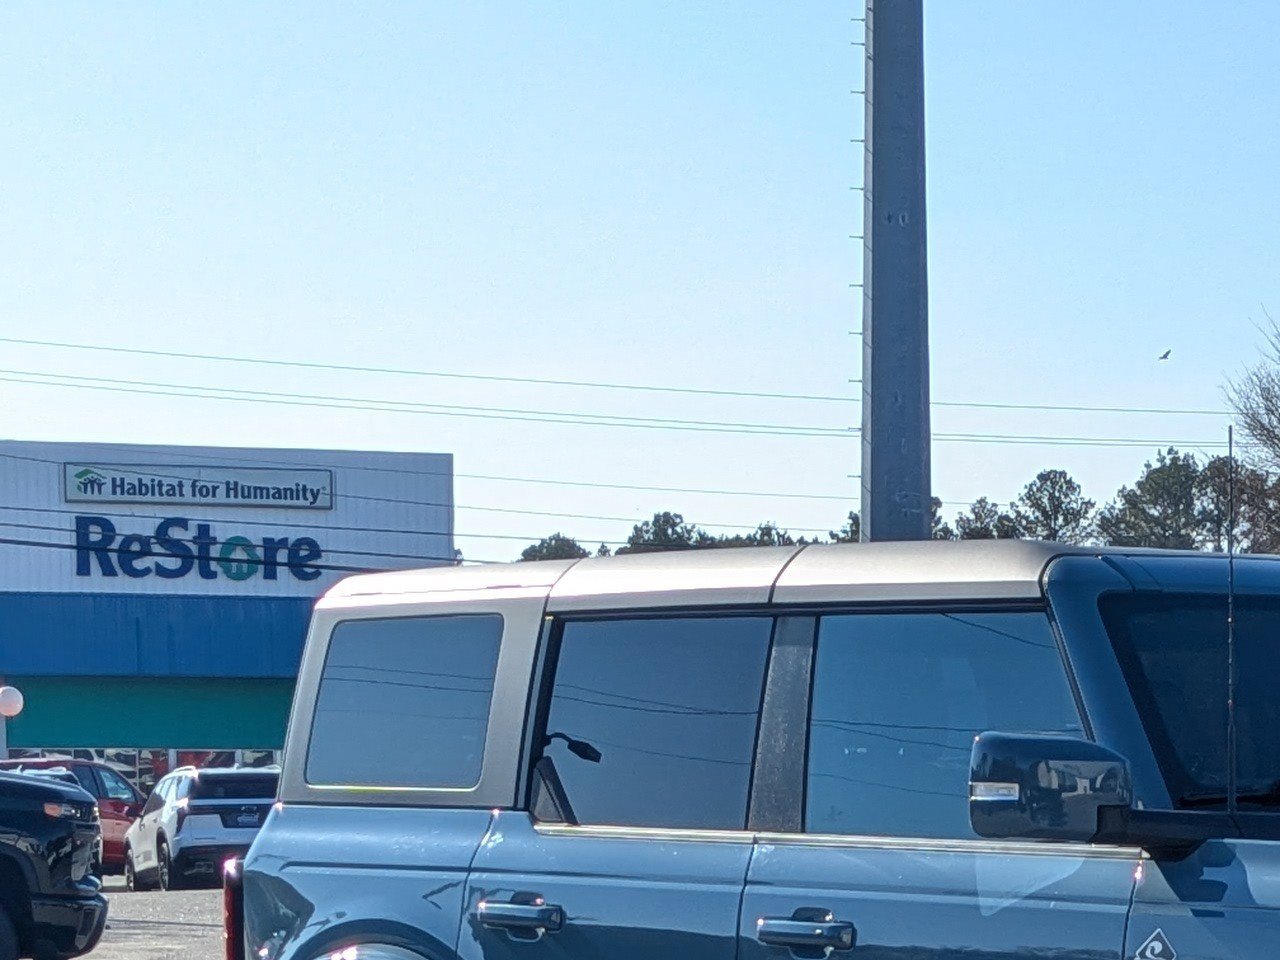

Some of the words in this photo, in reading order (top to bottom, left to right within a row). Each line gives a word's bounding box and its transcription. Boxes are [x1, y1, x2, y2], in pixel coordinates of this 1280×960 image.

[111, 477, 184, 498] Habitat
[191, 479, 220, 499] for
[225, 481, 321, 505] Humanity
[75, 515, 323, 581] ReStore
